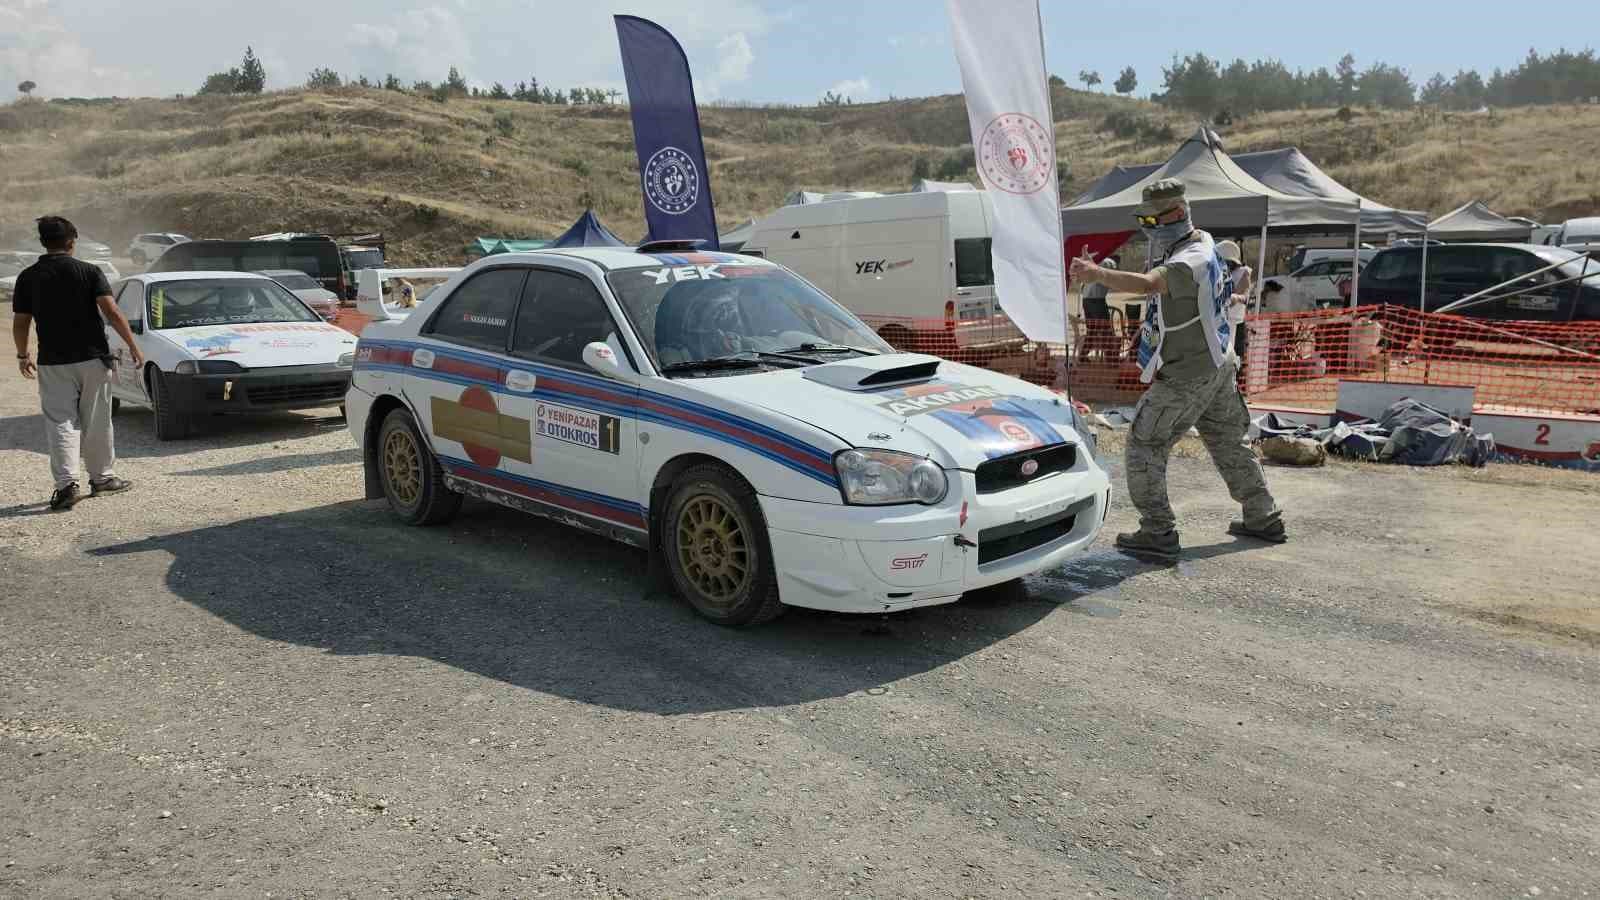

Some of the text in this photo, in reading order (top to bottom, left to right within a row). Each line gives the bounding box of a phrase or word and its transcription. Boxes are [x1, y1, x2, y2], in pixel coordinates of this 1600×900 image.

[642, 263, 726, 285] YEK
[855, 258, 886, 274] YEK
[547, 422, 598, 447] OTOKROS
[606, 417, 615, 453] 1
[1535, 423, 1551, 446] 2
